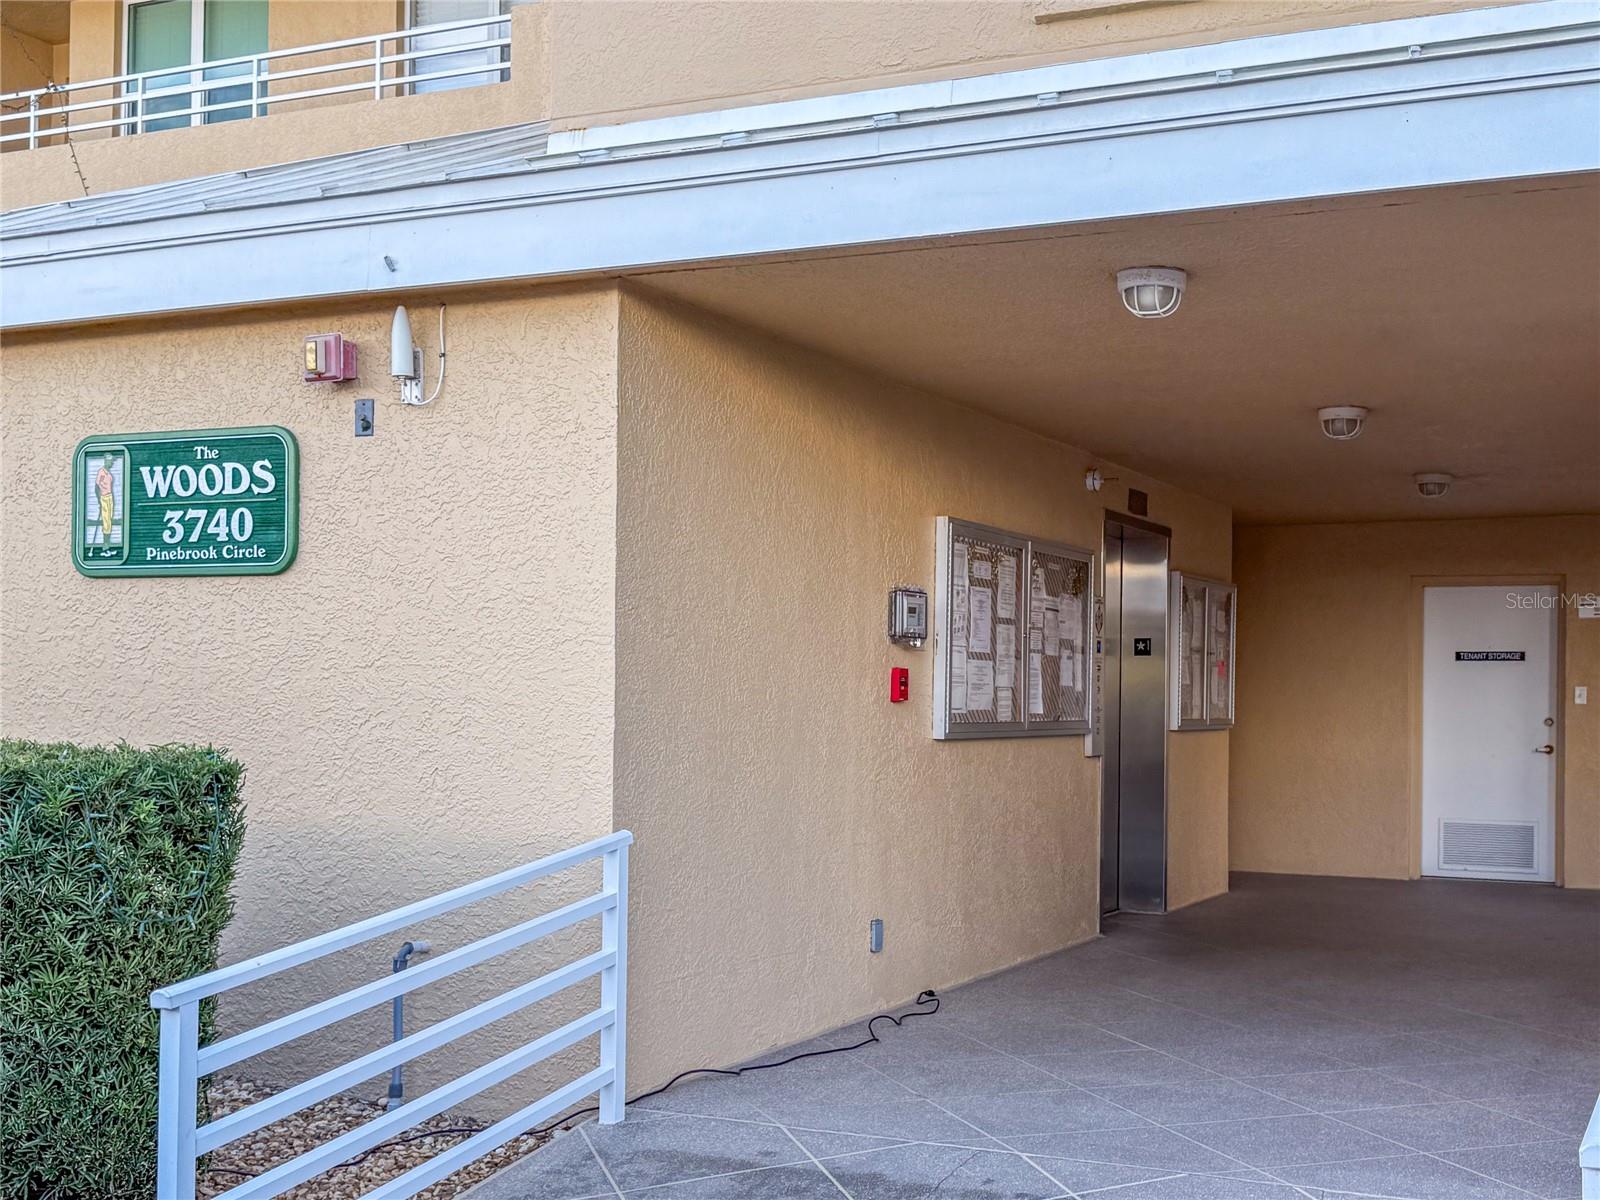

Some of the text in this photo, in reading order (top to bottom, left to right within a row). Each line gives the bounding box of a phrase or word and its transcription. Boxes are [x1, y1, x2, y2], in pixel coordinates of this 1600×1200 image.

[194, 446, 219, 459] The
[140, 459, 276, 498] WOODS
[162, 507, 253, 544] 3740
[146, 543, 266, 561] Pinebrook Circle
[1460, 652, 1520, 660] TENANT STORAGE
